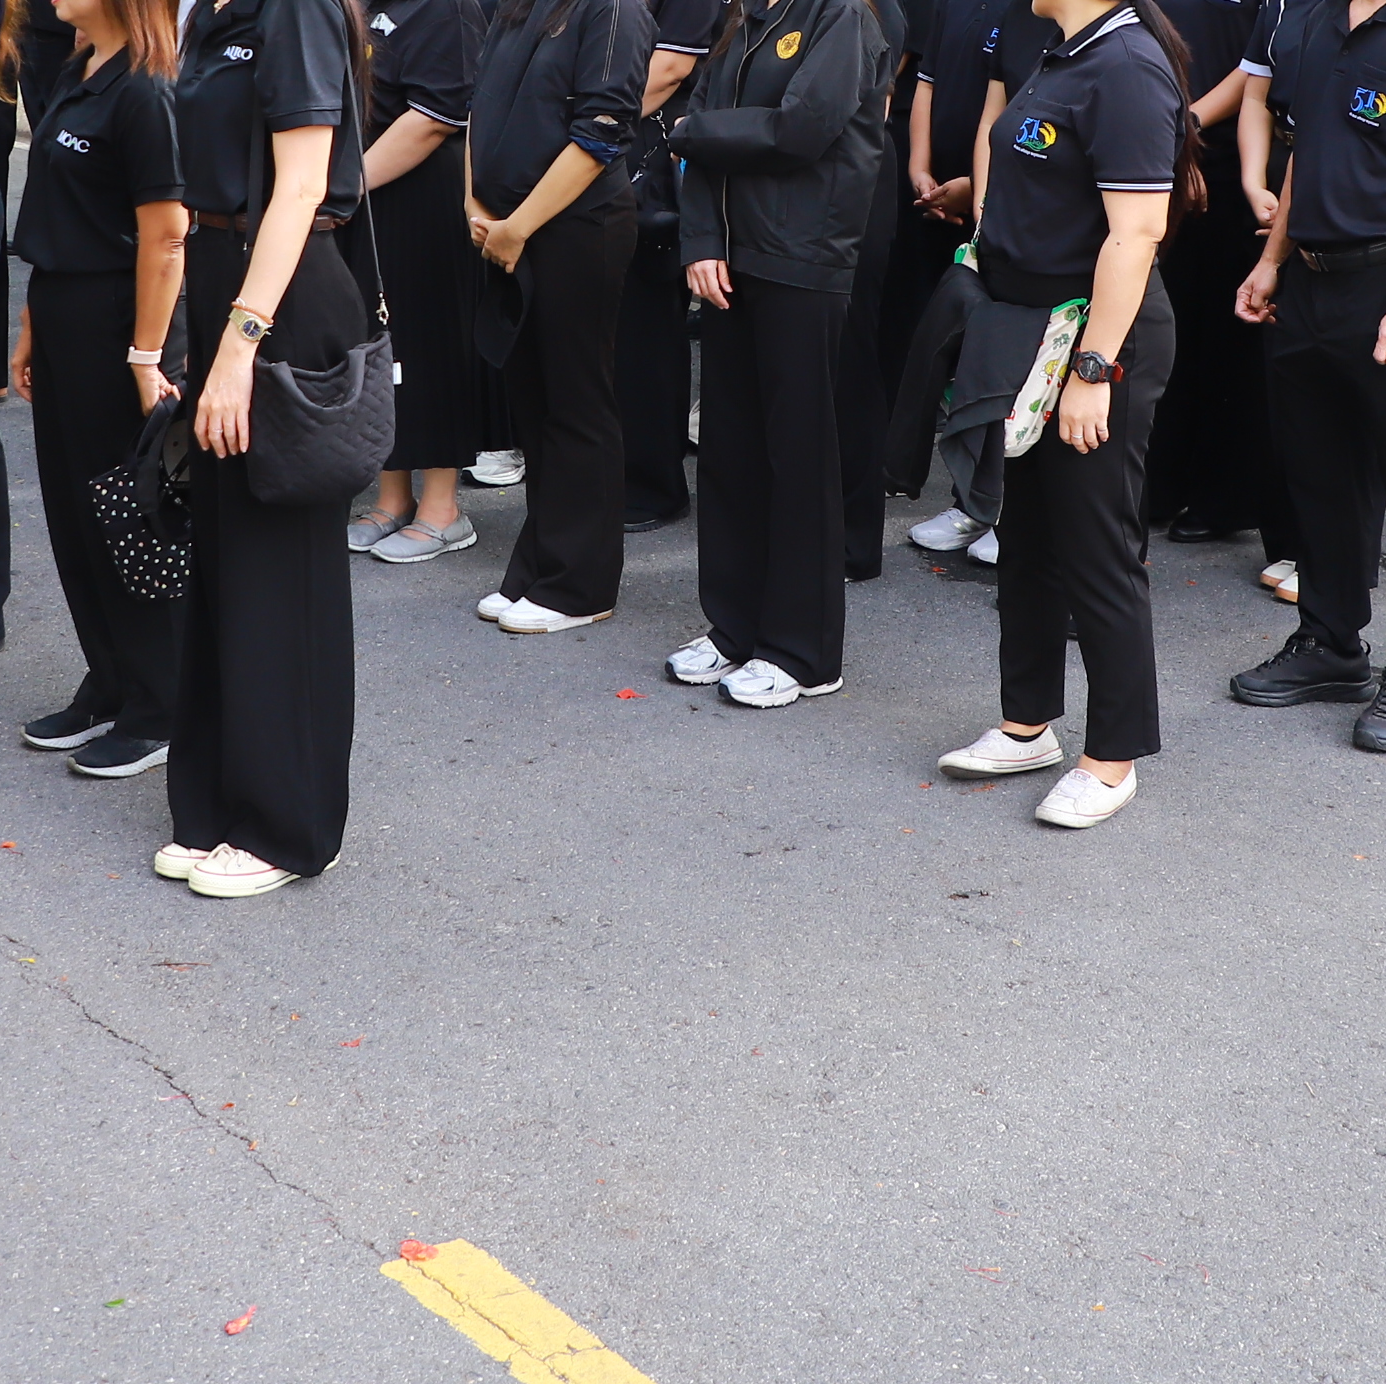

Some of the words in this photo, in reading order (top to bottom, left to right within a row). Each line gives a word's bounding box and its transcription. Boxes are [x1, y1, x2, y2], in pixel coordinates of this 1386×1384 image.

[223, 45, 253, 61] ALRO
[1350, 86, 1376, 112] 51
[56, 129, 91, 153] MOAC
[1016, 117, 1041, 143] 51
